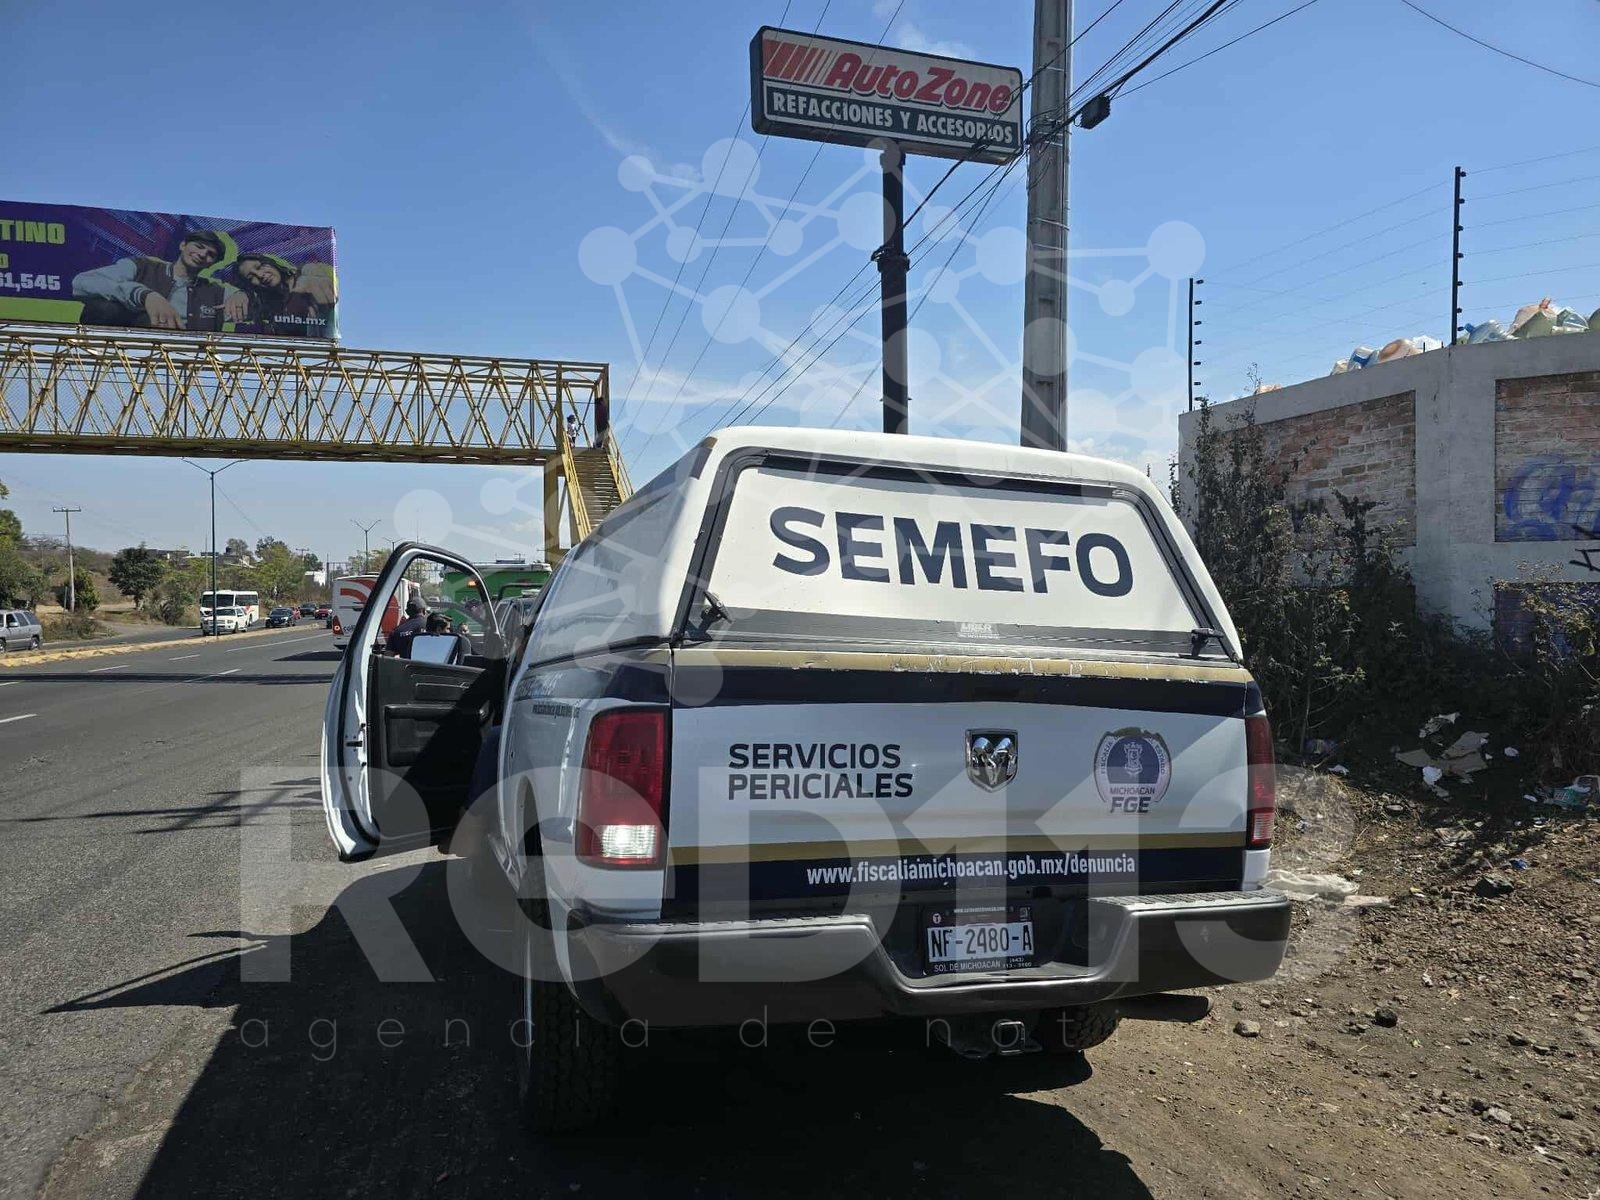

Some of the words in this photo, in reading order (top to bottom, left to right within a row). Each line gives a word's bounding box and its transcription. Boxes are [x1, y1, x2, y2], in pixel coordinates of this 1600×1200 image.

[822, 52, 1013, 114] AutoZone
[773, 92, 894, 128] REFACCIONES
[899, 113, 911, 130] Y
[274, 314, 326, 326] unla.mx
[769, 505, 1134, 598] SEMEFO
[728, 743, 901, 769] SERVICIOS
[728, 773, 914, 801] PERICIALES
[1110, 796, 1152, 813] FGE
[807, 852, 1136, 885] www.fiscaliamichoacan.gob.mx/denuncia
[931, 925, 1032, 957] NF-2480-A
